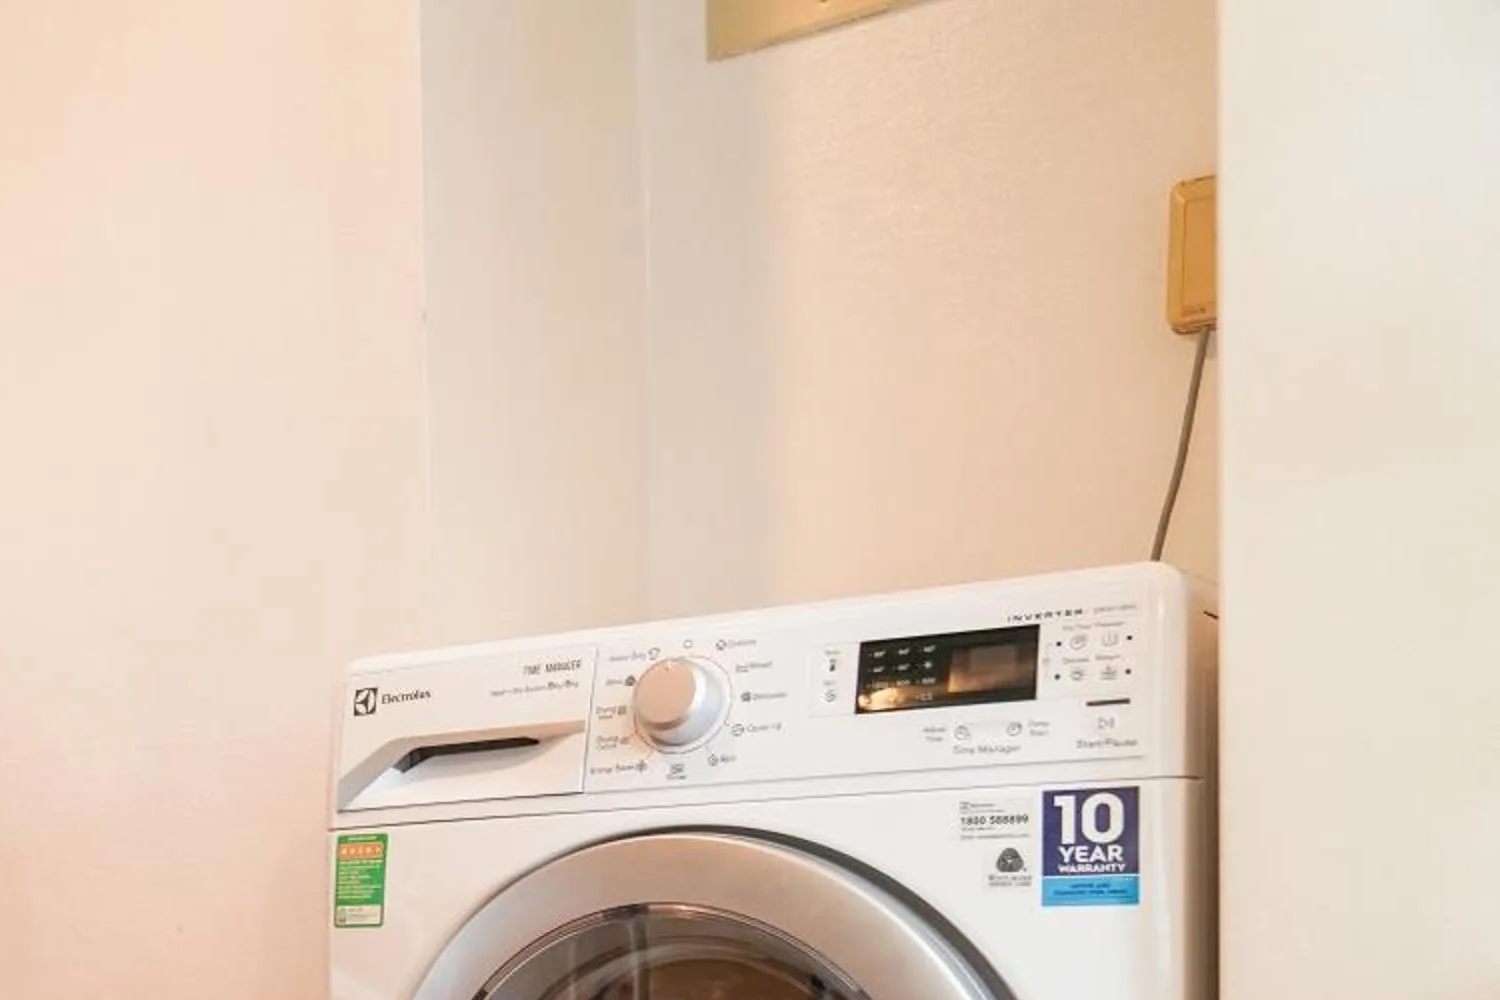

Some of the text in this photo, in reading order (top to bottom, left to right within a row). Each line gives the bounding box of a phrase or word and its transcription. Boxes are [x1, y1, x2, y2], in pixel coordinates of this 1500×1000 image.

[1006, 607, 1084, 622] INVERTER
[381, 689, 432, 705] Electrolux
[1053, 791, 1125, 845] 10
[1058, 844, 1124, 863] YEAR
[1057, 862, 1127, 874] WARRANTY
